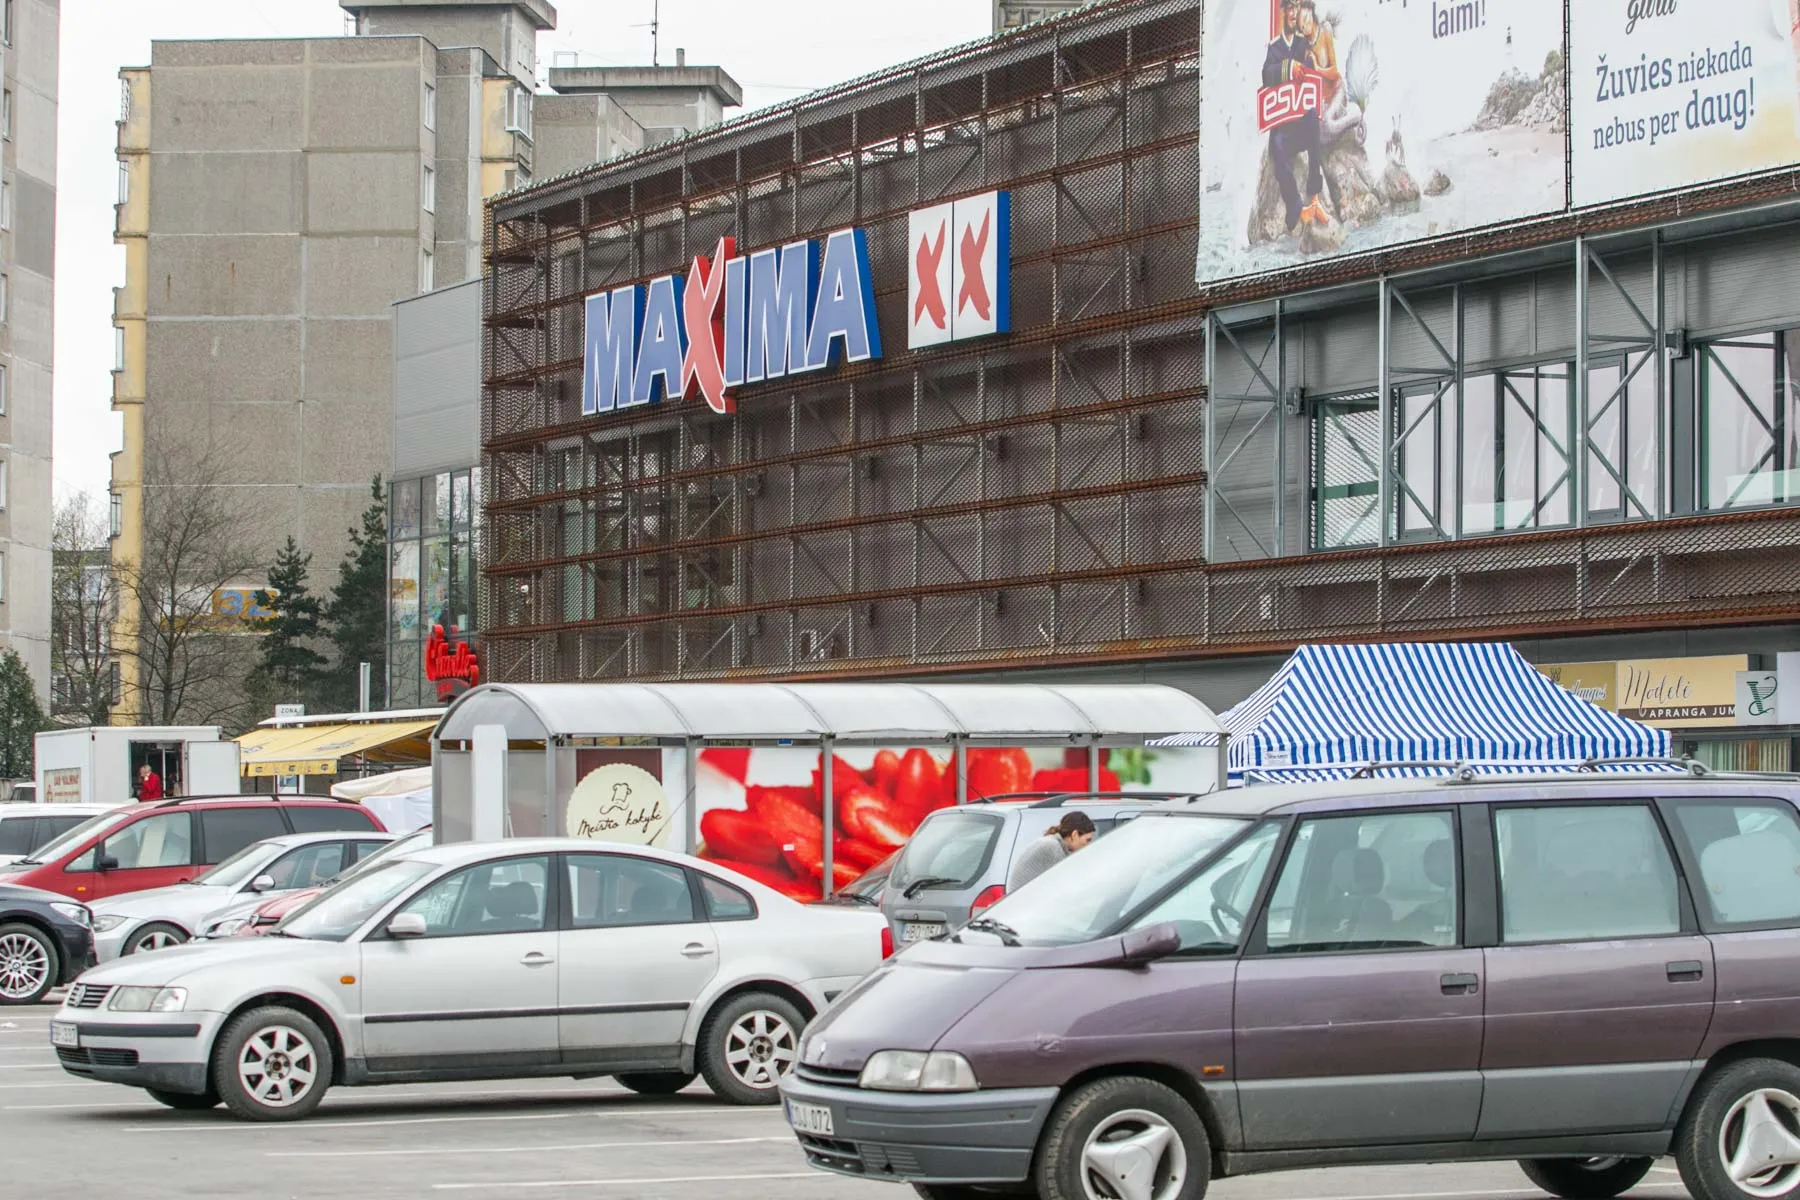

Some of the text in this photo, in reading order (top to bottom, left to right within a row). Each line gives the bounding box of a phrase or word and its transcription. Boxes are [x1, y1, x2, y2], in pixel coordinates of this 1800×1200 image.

[1432, 0, 1486, 39] laimi!
[1596, 40, 1753, 102] Žuvies niekada
[1263, 82, 1317, 121] esva
[1593, 76, 1755, 150] nebus per daug!
[582, 228, 880, 415] MAXIMA
[1650, 706, 1707, 719] APRANGA
[577, 801, 662, 838] Meistro kokybė
[811, 1109, 831, 1132] 072
